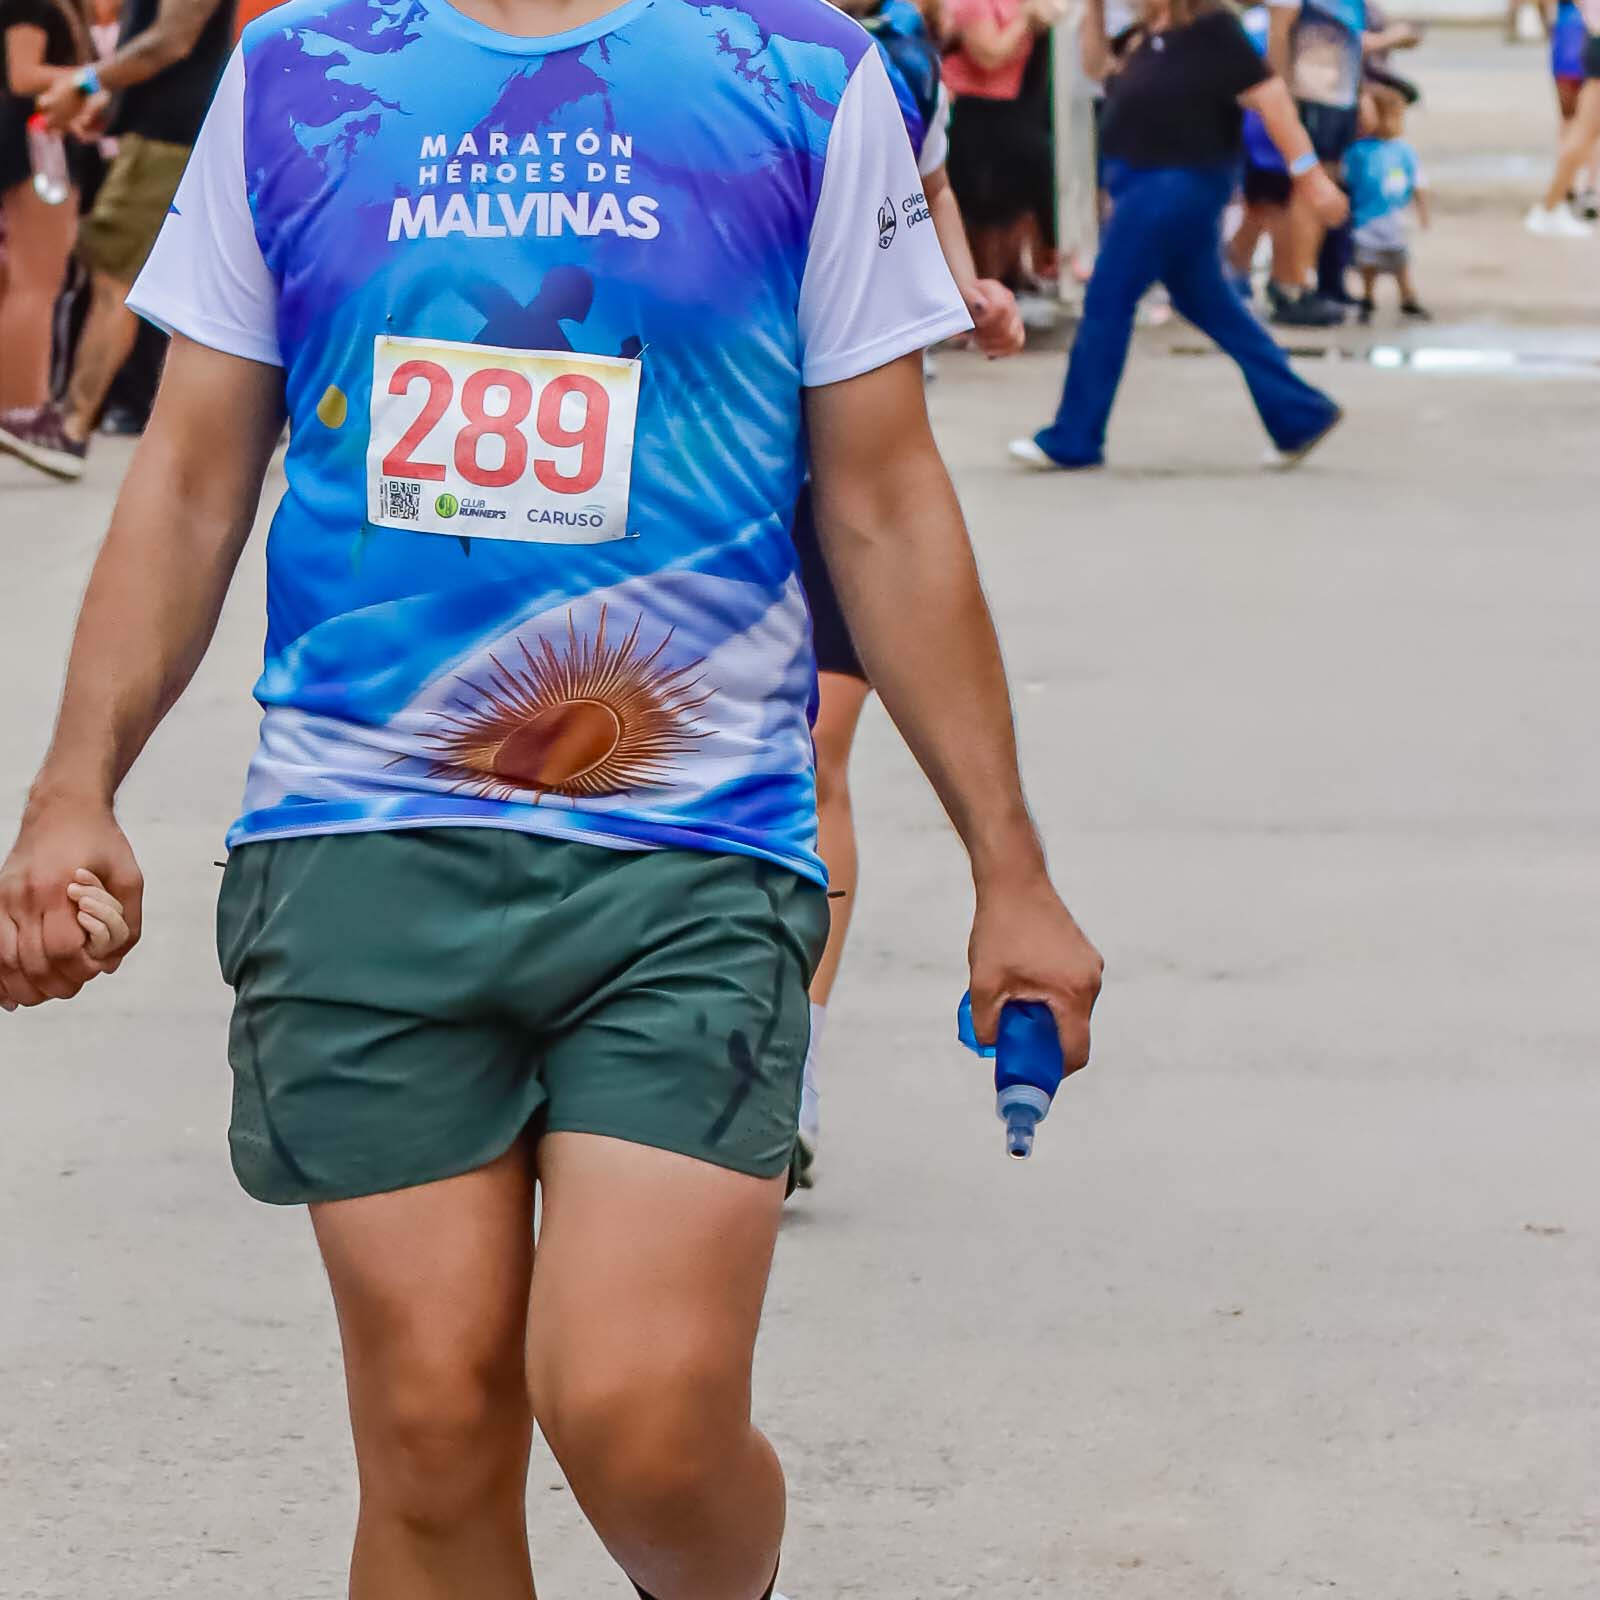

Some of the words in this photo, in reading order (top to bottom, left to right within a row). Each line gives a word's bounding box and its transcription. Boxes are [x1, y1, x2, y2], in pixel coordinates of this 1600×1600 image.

[419, 128, 633, 159] MARATÓN
[419, 160, 566, 186] HÉROES
[587, 162, 632, 185] DE
[387, 192, 661, 241] MALVINAS
[382, 360, 610, 495] 289
[458, 506, 507, 520] RUNNER'S
[461, 498, 486, 510] CLUB
[527, 508, 604, 528] CARUSO
